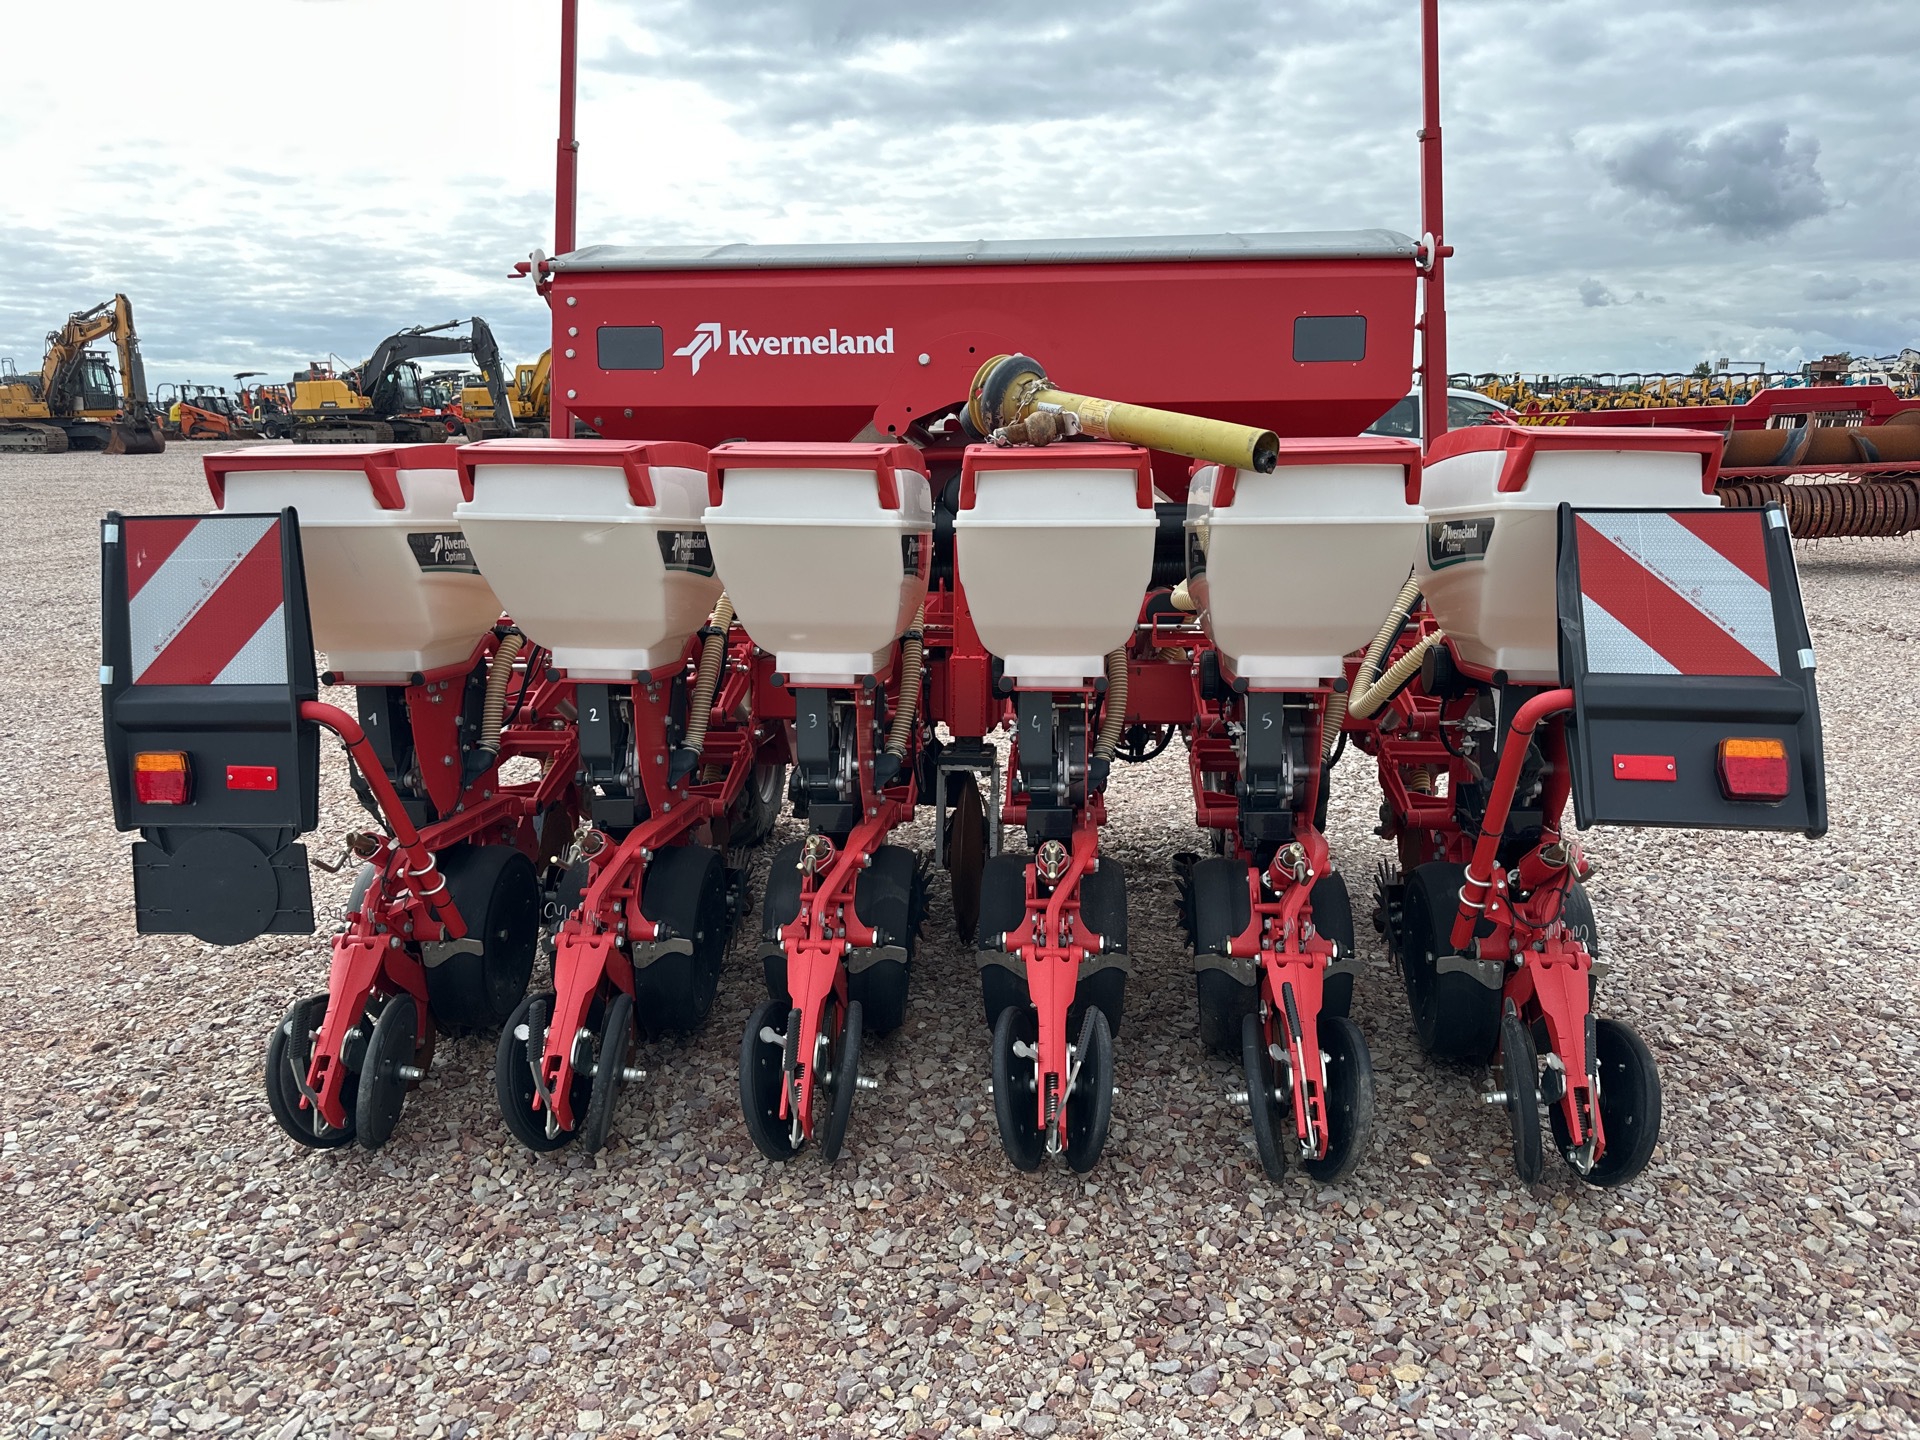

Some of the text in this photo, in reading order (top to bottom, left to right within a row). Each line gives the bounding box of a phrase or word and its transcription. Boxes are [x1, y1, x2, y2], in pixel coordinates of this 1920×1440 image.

[728, 328, 895, 356] Kverneland
[1546, 415, 1571, 427] 45
[1447, 523, 1478, 540] Kverneland
[680, 533, 707, 549] Kverneland
[444, 551, 466, 564] Optima
[368, 712, 378, 726] 1
[589, 707, 600, 722] 2
[808, 713, 818, 729] 3
[1261, 711, 1273, 730] 5
[1031, 715, 1041, 733] 4
